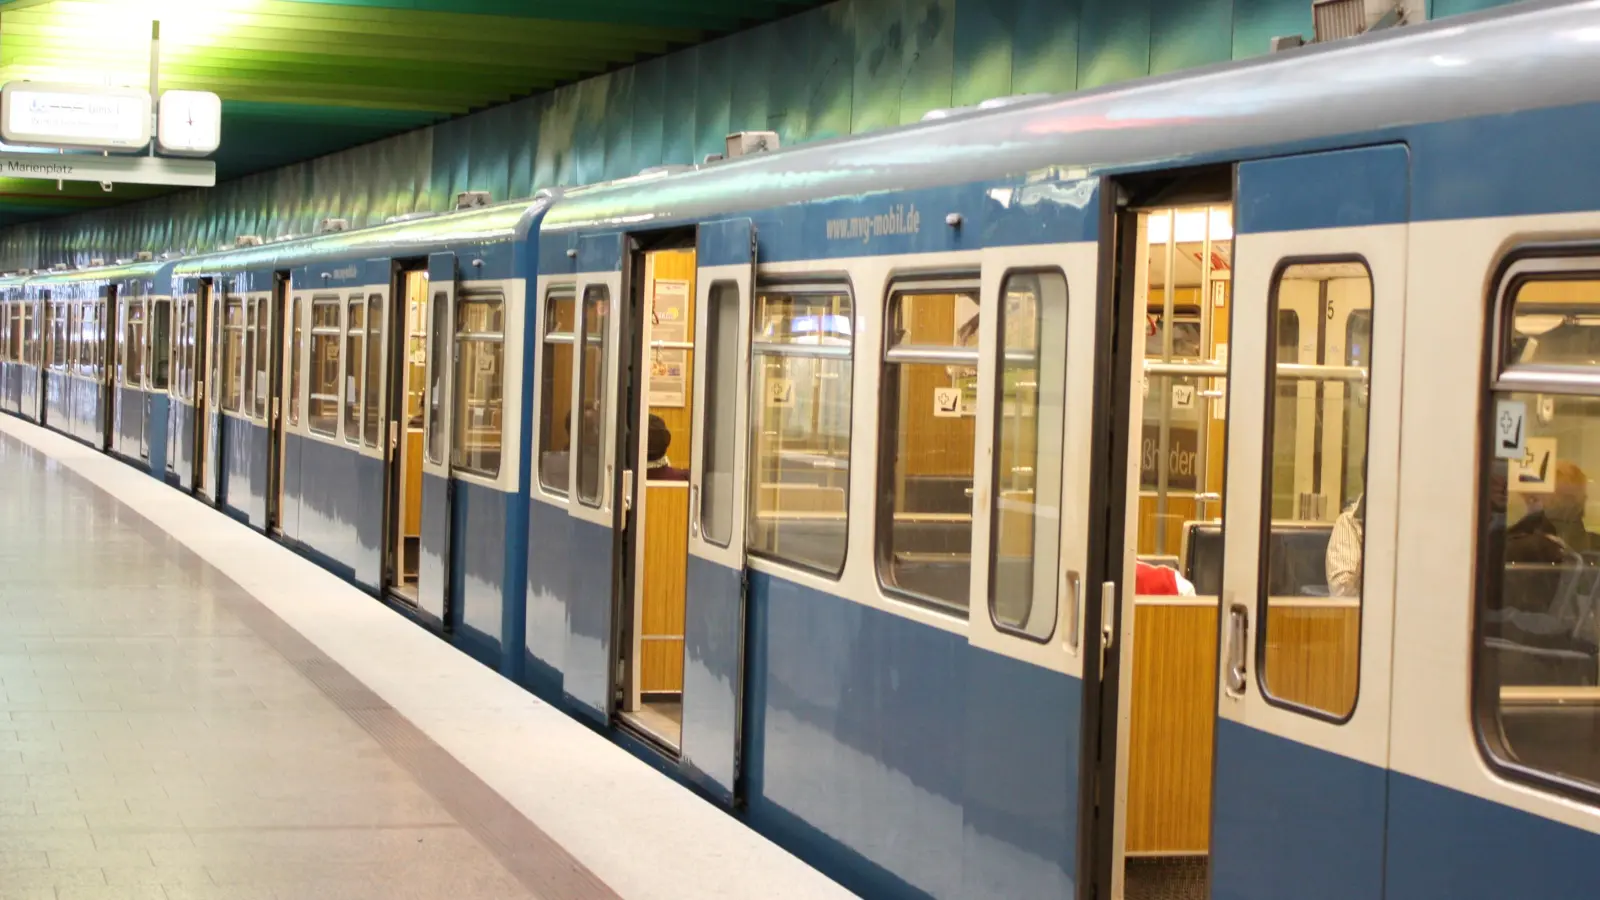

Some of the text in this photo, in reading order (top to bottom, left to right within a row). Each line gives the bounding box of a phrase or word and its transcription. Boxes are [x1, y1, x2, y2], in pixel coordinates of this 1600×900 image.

[8, 160, 73, 175] Marienplatz
[826, 203, 920, 244] www.mvg-mobil.de
[1327, 300, 1335, 320] 5
